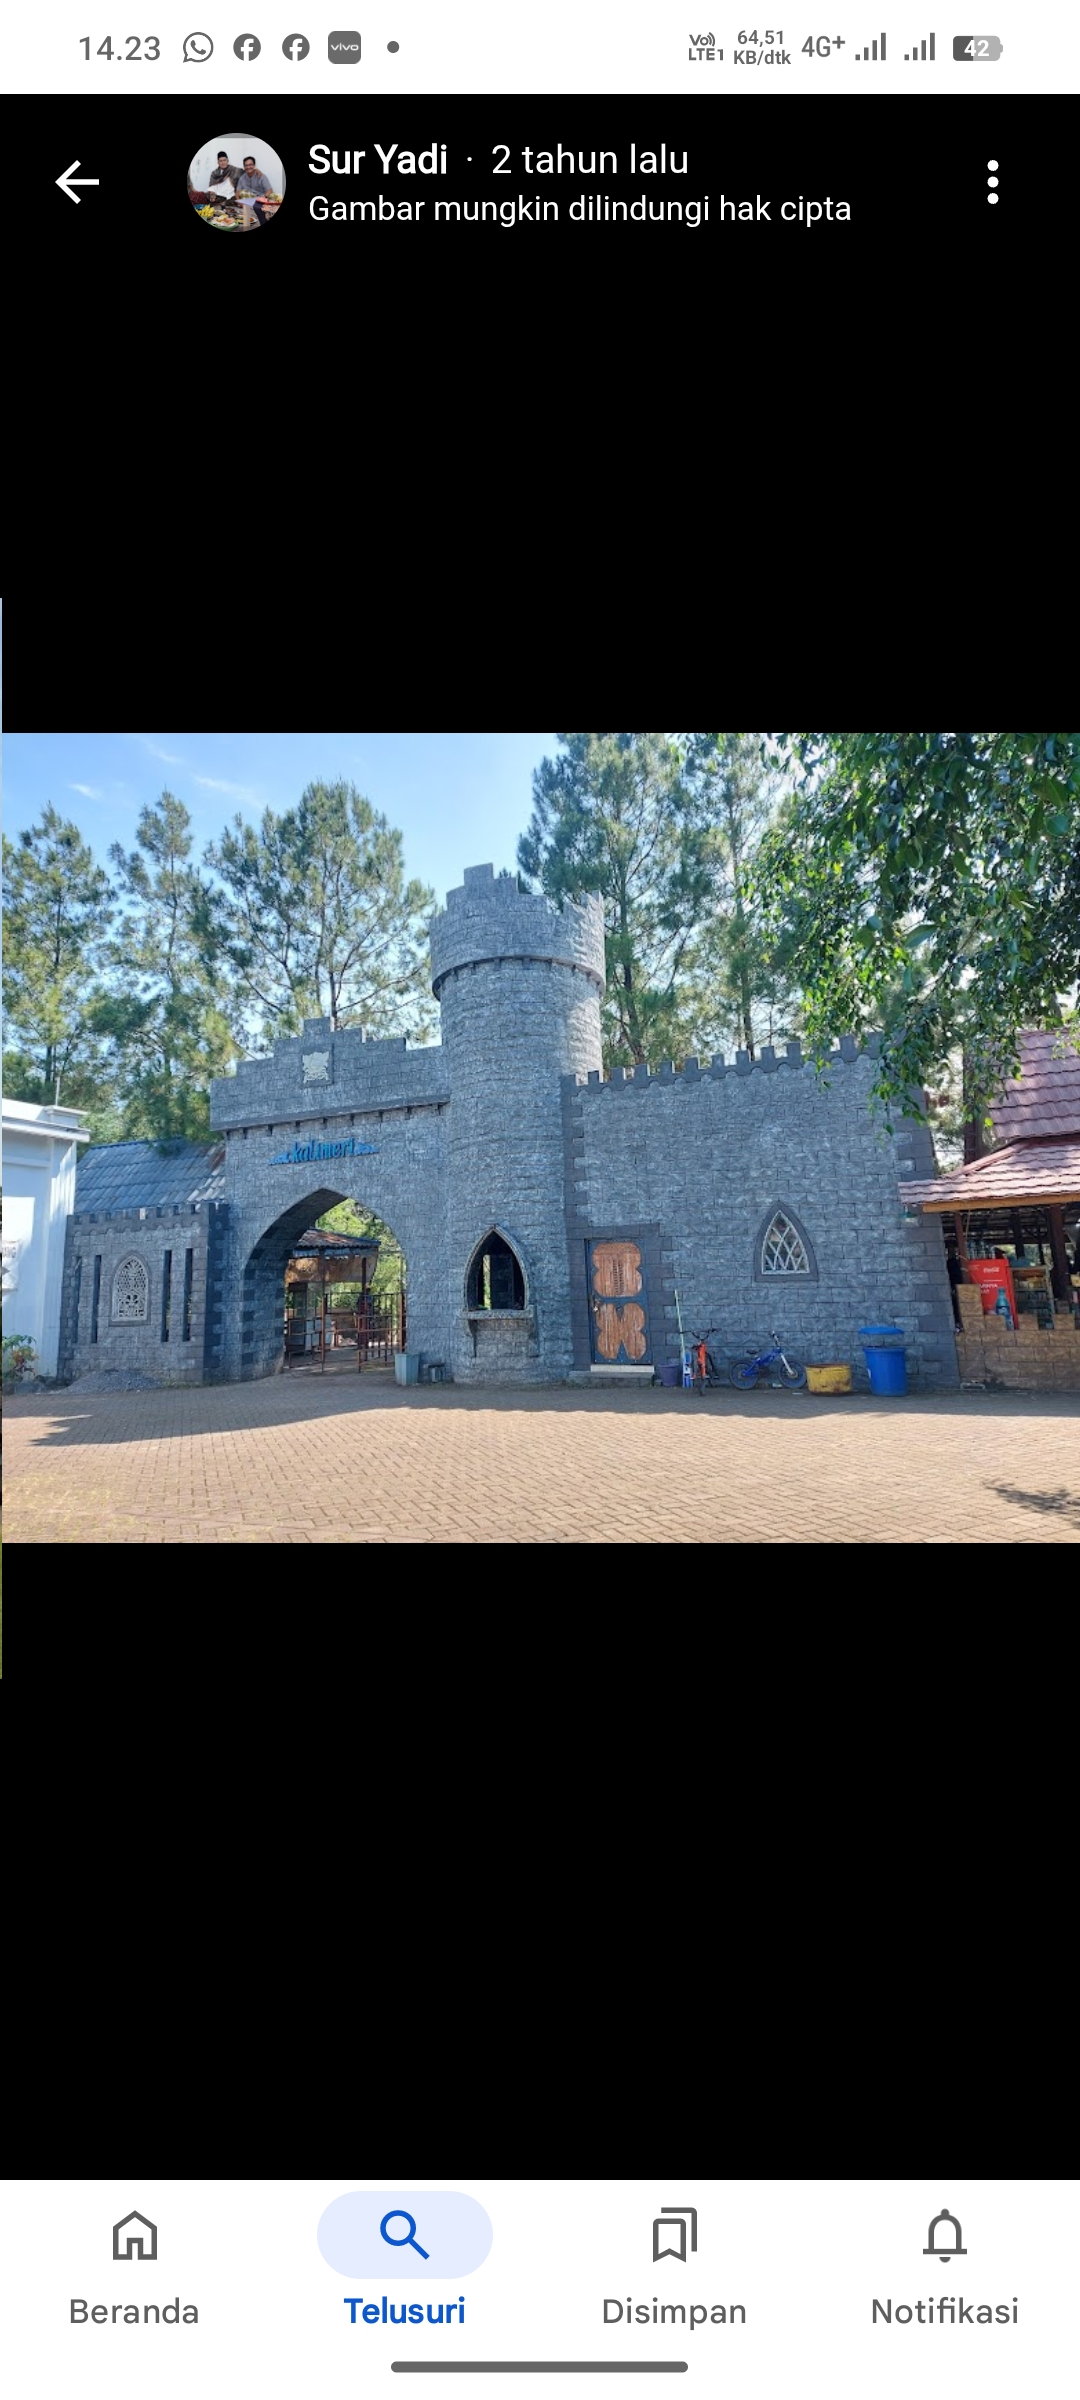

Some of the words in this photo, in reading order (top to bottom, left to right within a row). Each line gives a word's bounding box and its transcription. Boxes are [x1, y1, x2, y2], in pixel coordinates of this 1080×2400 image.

[79, 35, 161, 61] 14.23
[330, 43, 359, 51] vivo
[737, 29, 783, 47] 64,51
[801, 35, 846, 58] 4G+
[963, 39, 990, 57] 42
[688, 48, 724, 61] LTE1
[733, 49, 792, 66] KB/dtk
[308, 143, 366, 175] Sur
[373, 142, 448, 175] Yadi
[491, 144, 512, 174] 2
[521, 142, 618, 174] tahun
[630, 142, 688, 174] lalu
[309, 194, 426, 221] Gambar
[434, 194, 559, 228] mungkin
[568, 194, 710, 228] dilindungi
[720, 194, 772, 221] hak
[780, 195, 852, 228] cipta
[70, 2296, 199, 2325] Beranda
[343, 2295, 466, 2325] Telusuri
[603, 2296, 746, 2331] Disimpan
[872, 2296, 1019, 2325] Notifikasi
